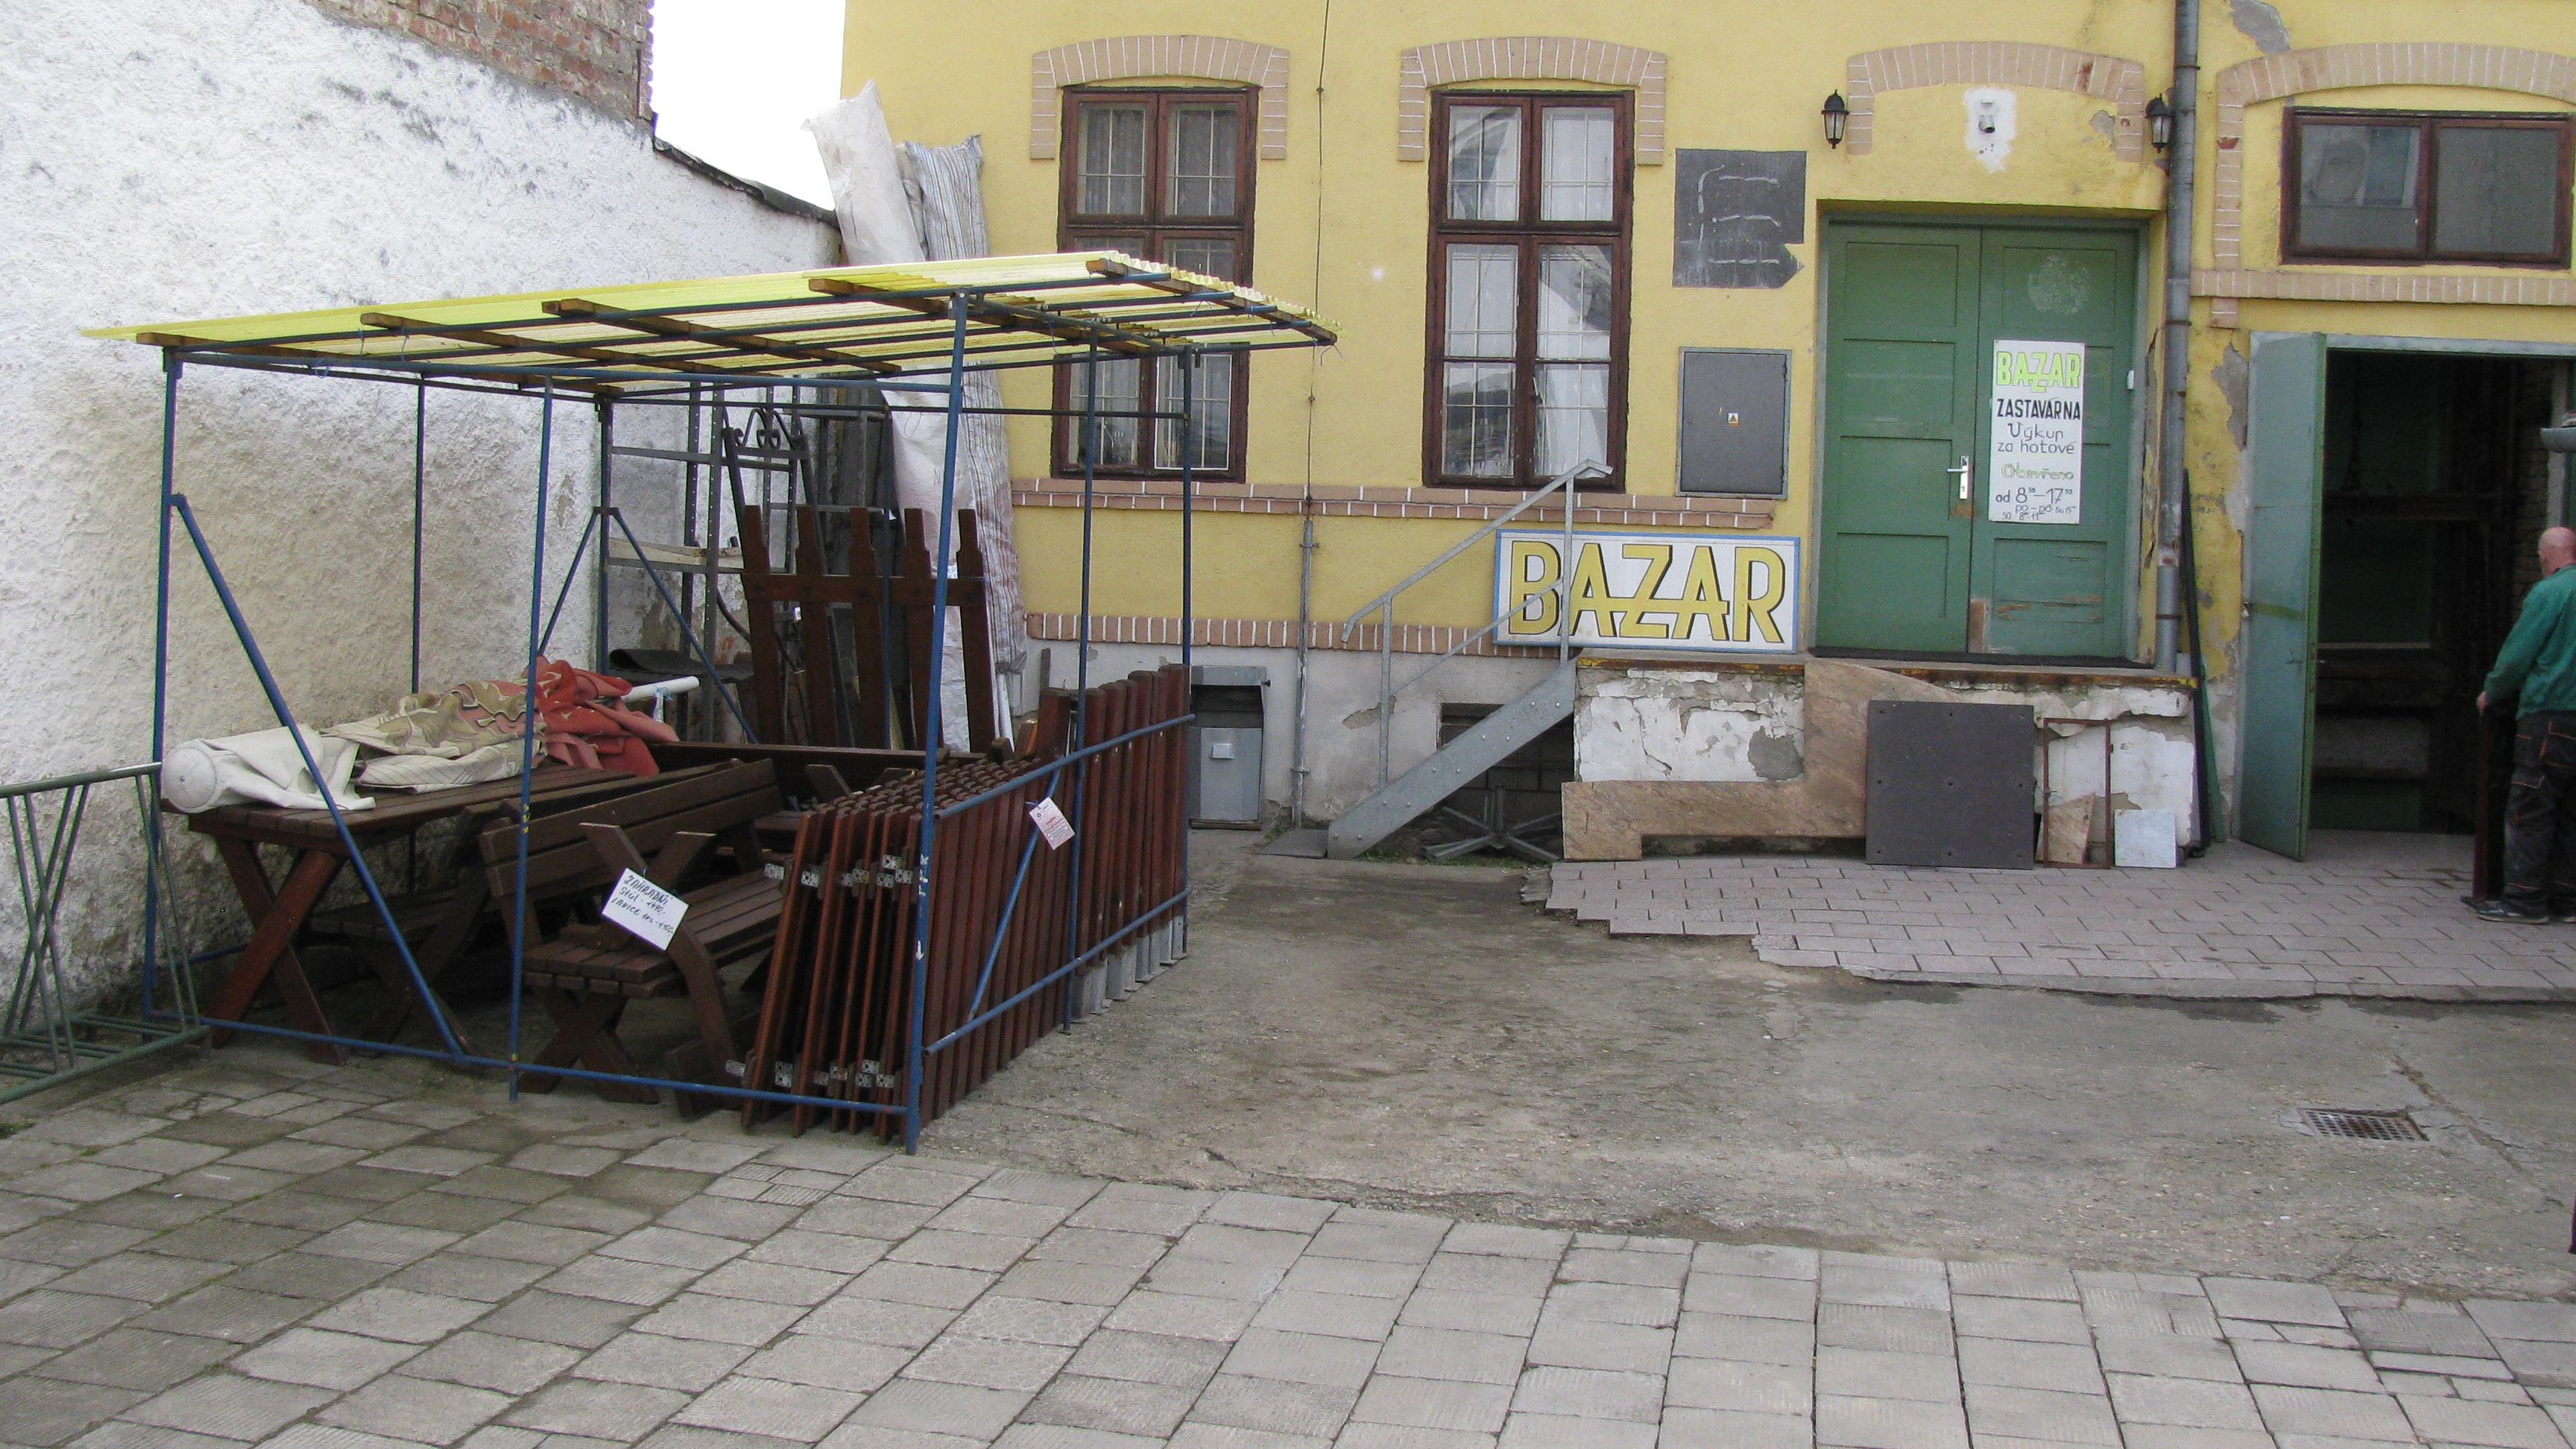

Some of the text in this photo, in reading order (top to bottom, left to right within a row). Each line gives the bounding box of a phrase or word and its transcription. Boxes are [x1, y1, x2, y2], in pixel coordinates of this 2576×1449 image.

[1996, 351, 2081, 393] BAZAR
[1997, 397, 2081, 420] ZASTAVÁRNA
[1998, 439, 2077, 454] za hotové
[1995, 489, 2010, 502] od
[1508, 540, 1786, 643] BAZAR
